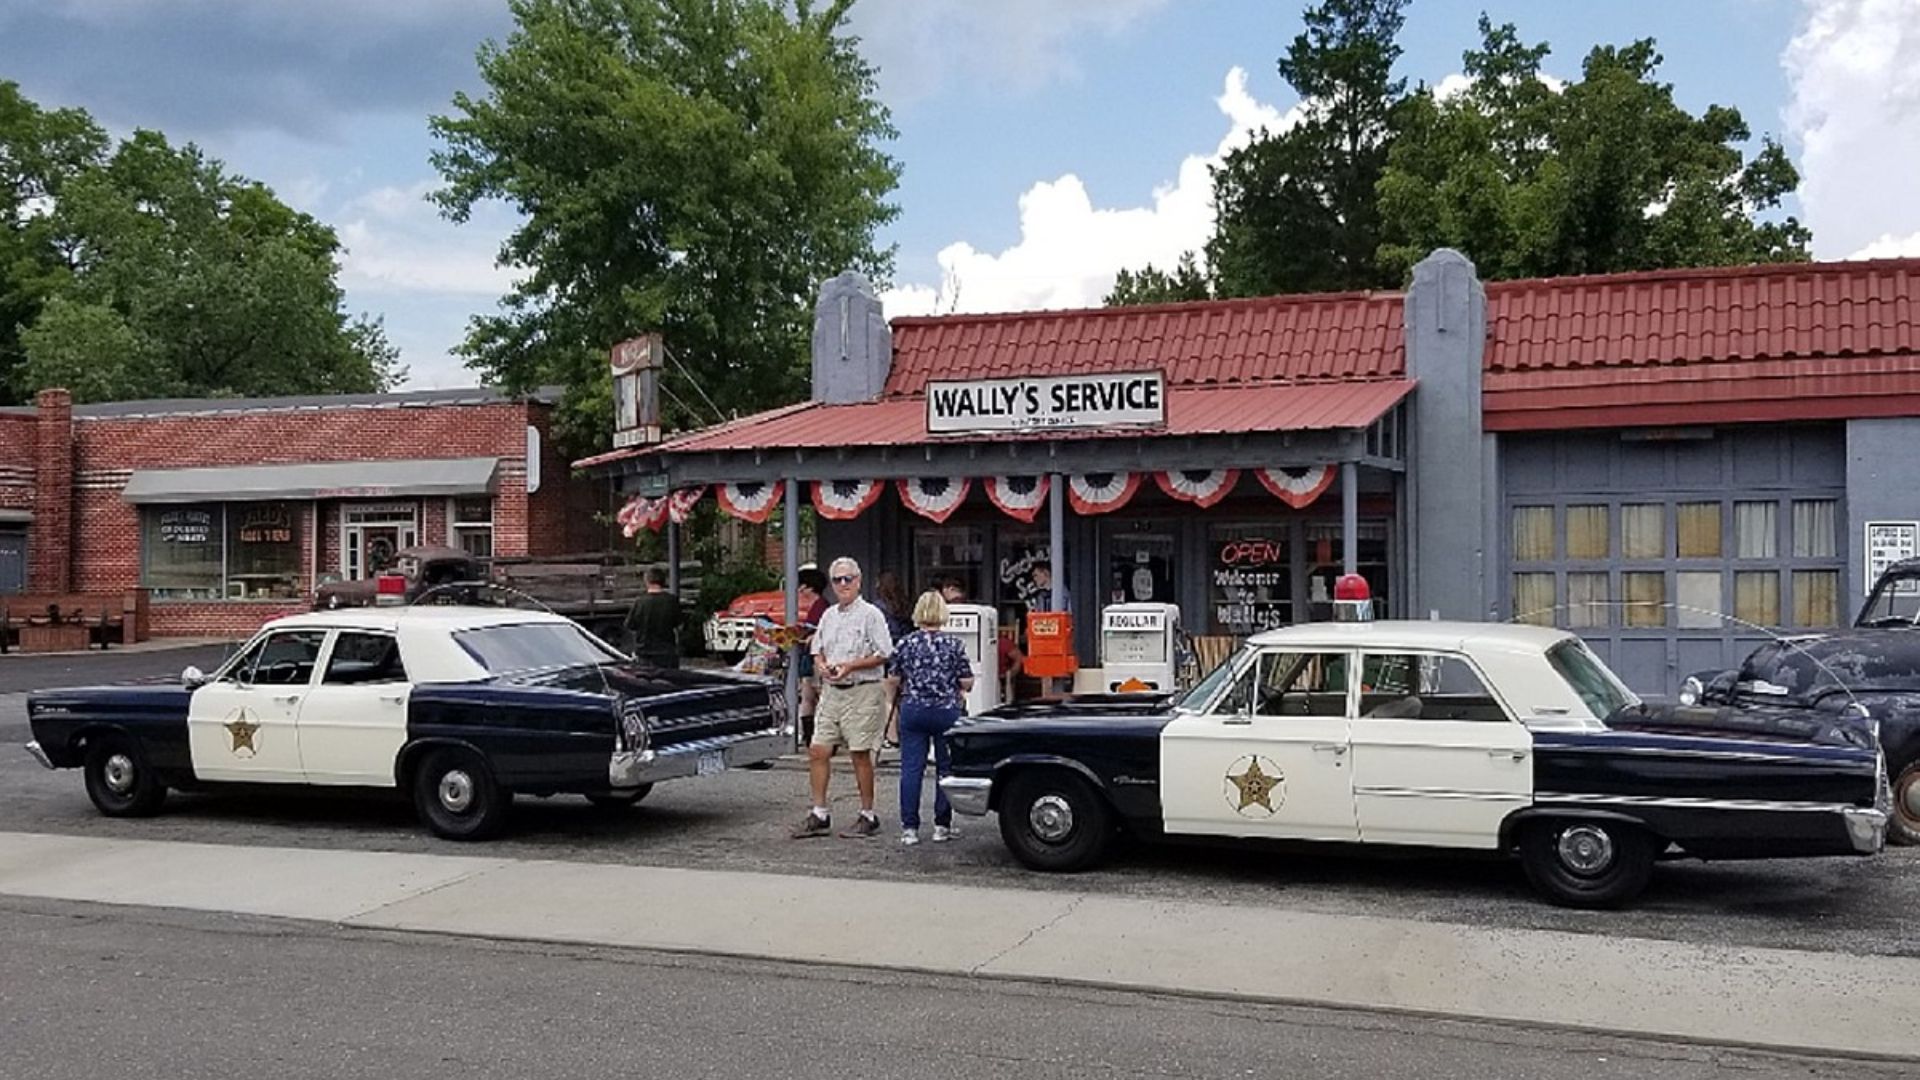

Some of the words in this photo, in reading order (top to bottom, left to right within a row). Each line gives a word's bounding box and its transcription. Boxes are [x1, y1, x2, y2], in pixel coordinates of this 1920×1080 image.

[934, 382, 1039, 417] WALLY'S
[1050, 379, 1160, 413] SERVICE
[1221, 543, 1281, 563] OPEN
[1213, 568, 1280, 586] Welcome
[1237, 588, 1256, 606] to
[1109, 615, 1158, 628] REGULAR
[1217, 603, 1281, 631] Wally's
